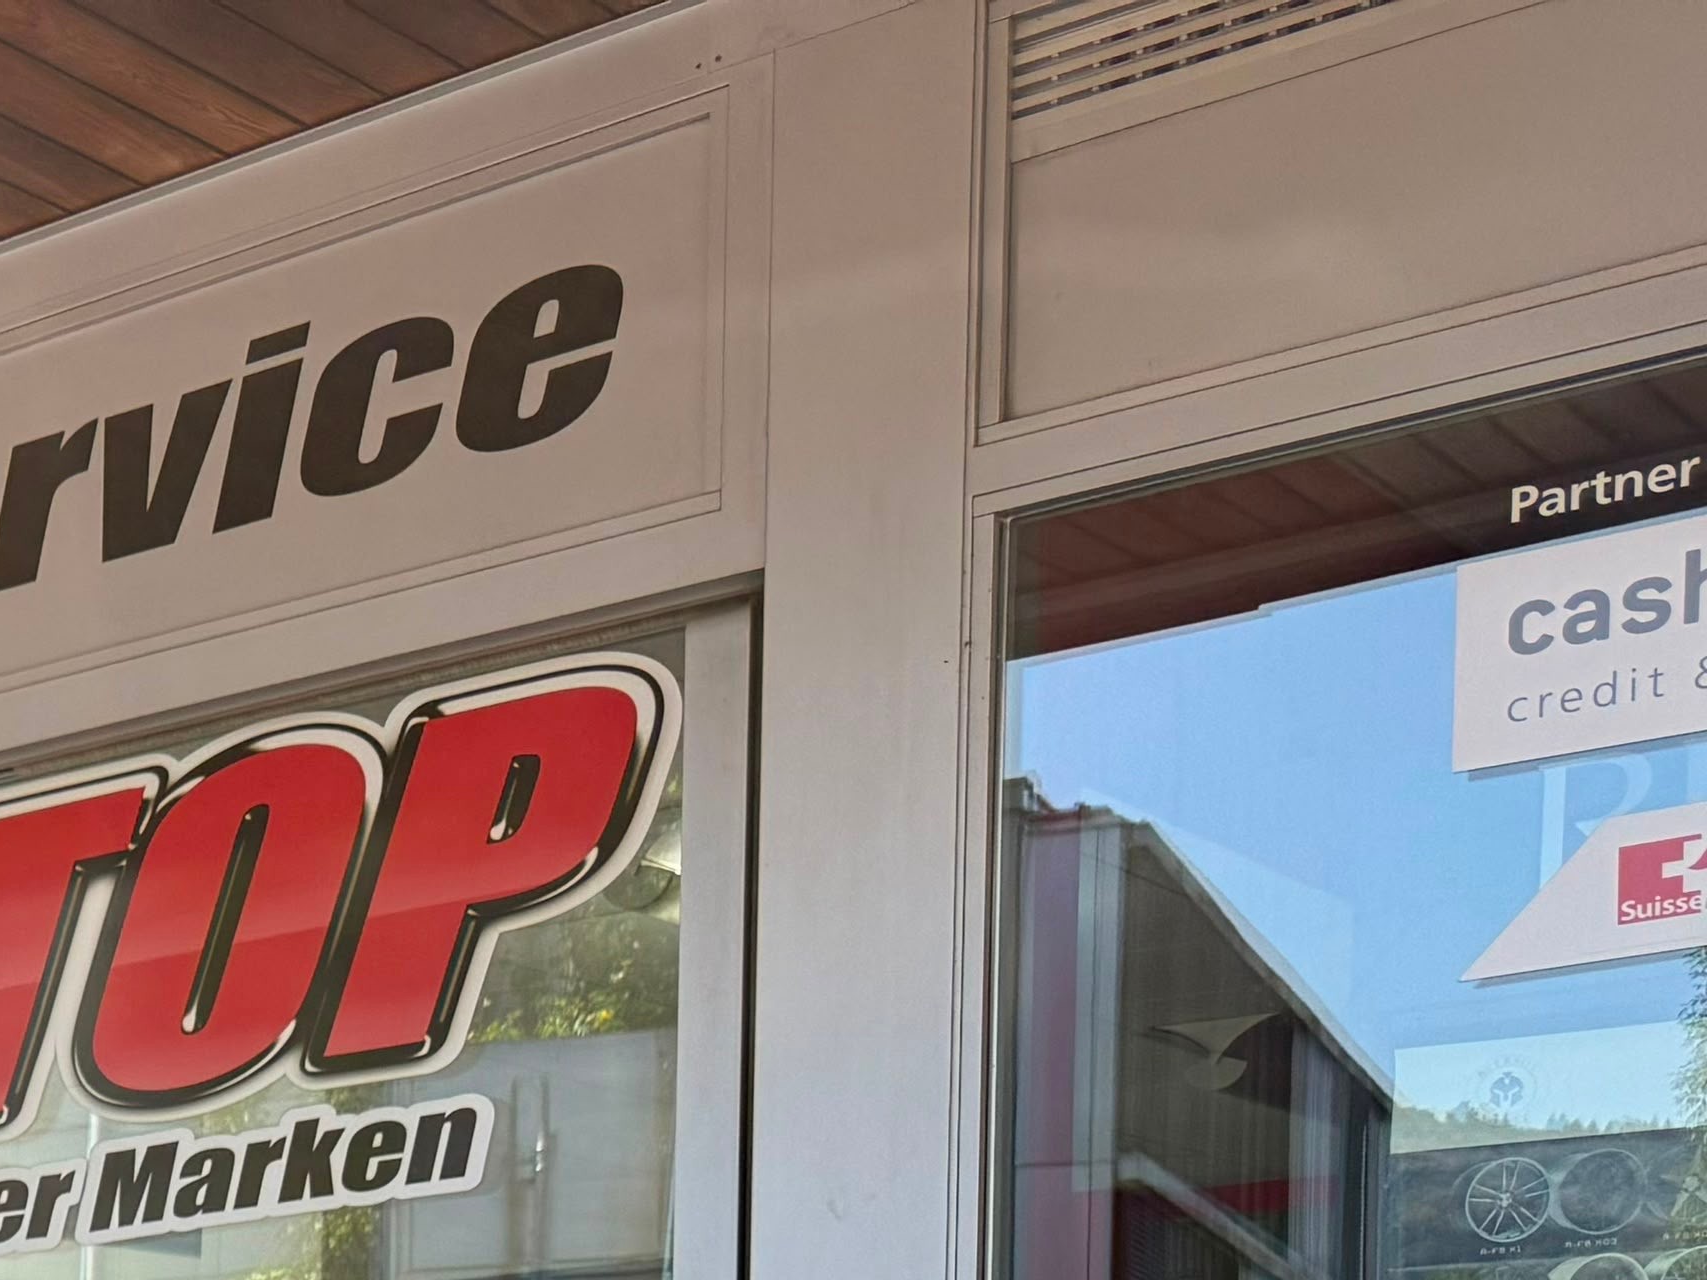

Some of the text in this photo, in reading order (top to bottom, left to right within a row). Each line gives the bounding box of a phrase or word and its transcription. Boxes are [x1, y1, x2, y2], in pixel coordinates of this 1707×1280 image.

[1511, 456, 1701, 523] Partner
[1507, 667, 1664, 722] credit
[91, 1100, 479, 1231] Marken
